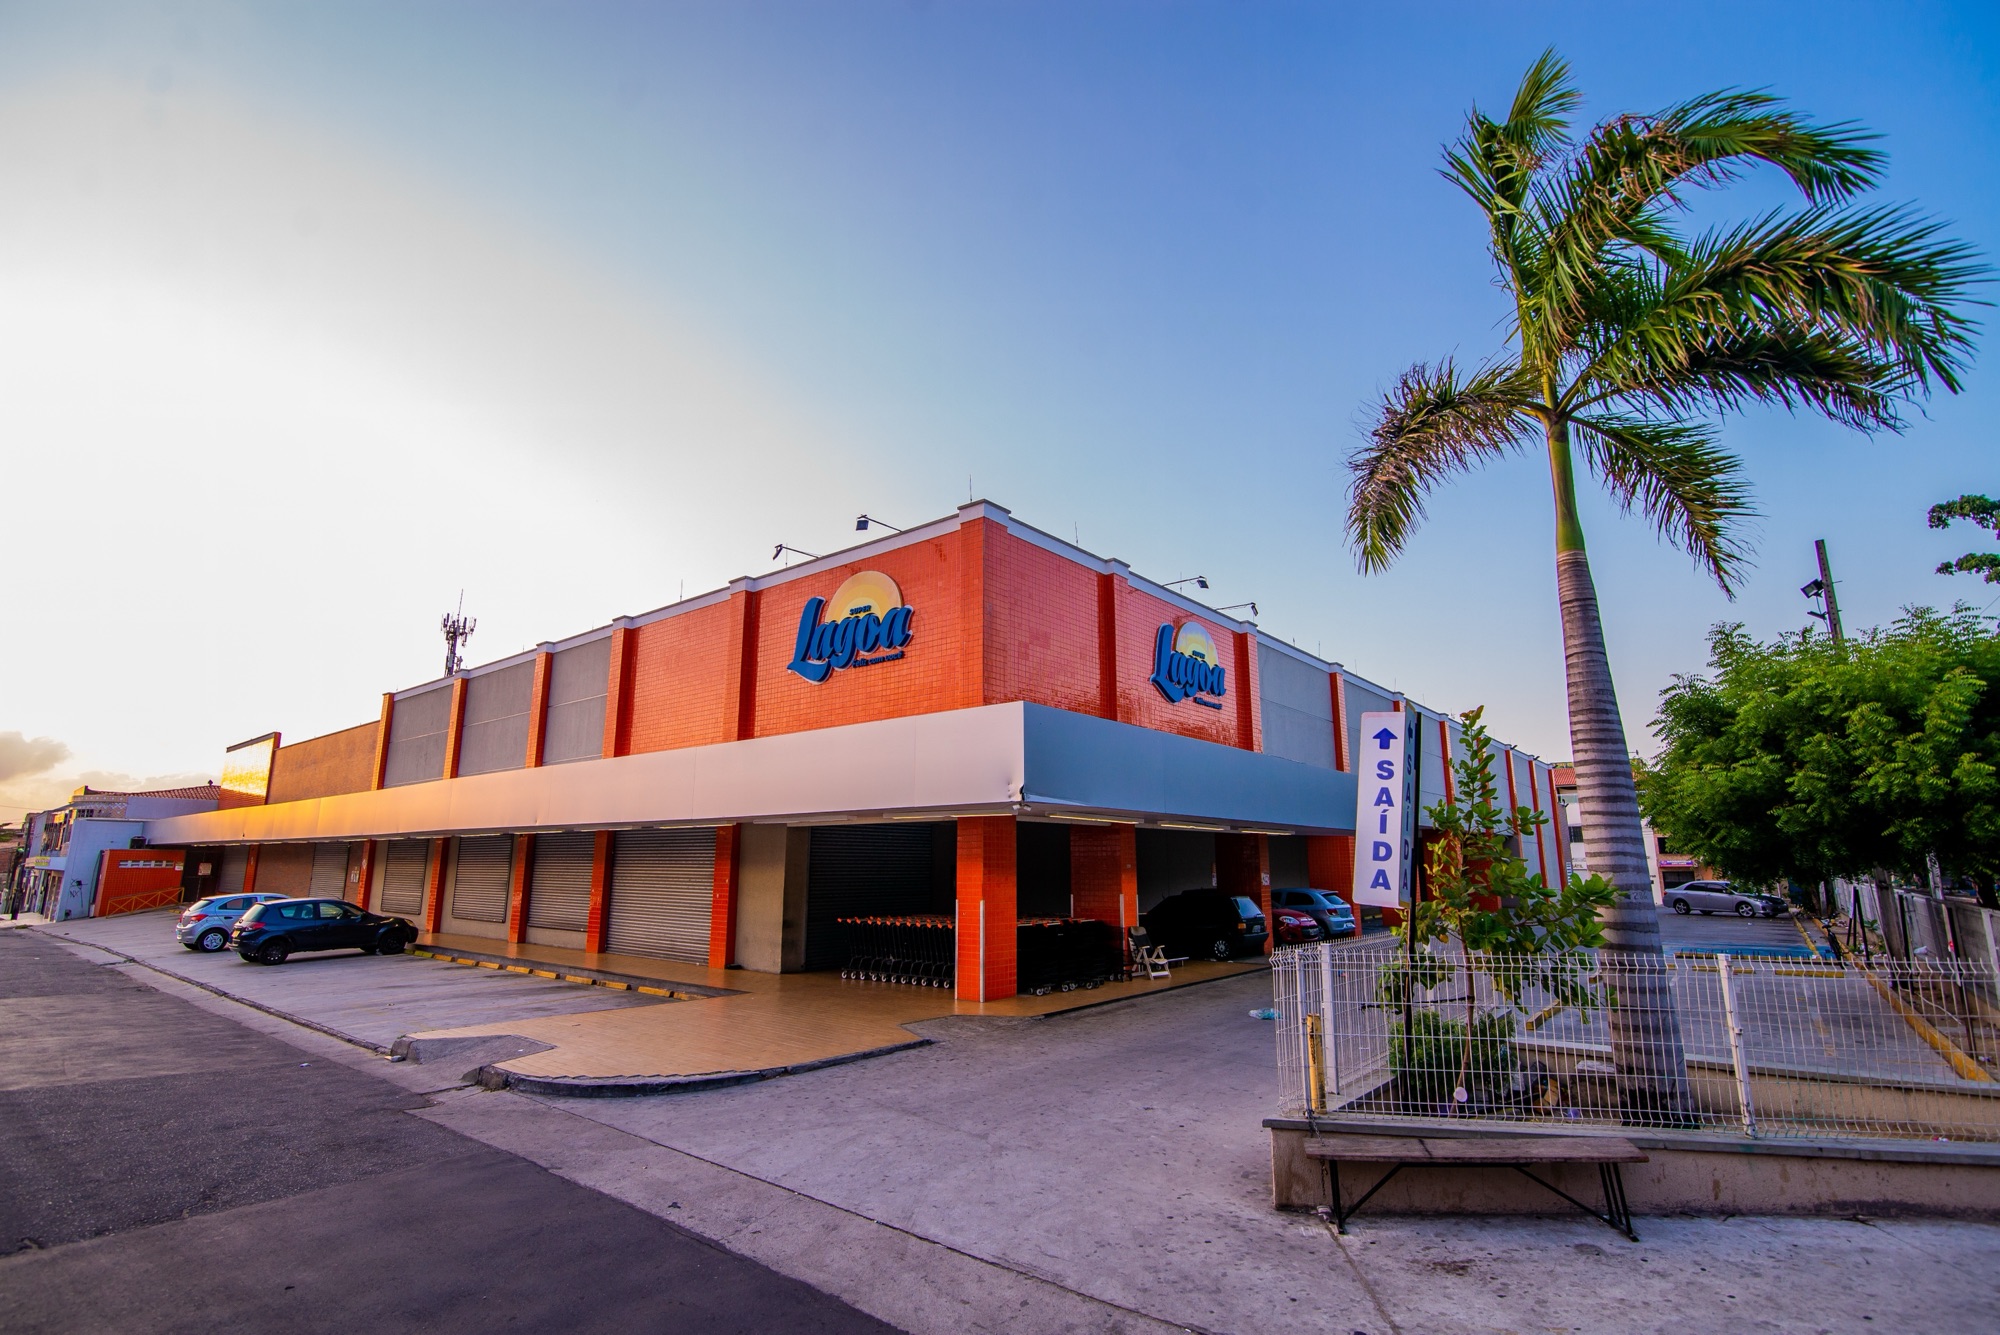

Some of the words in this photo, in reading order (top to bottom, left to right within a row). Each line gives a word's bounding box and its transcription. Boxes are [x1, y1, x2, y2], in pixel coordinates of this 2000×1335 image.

[787, 596, 913, 684] Lagoa
[849, 605, 872, 615] SUPER
[1149, 622, 1227, 705] Lagoa
[1370, 759, 1395, 891] SAÍDA
[1402, 759, 1412, 891] SAÍDA
